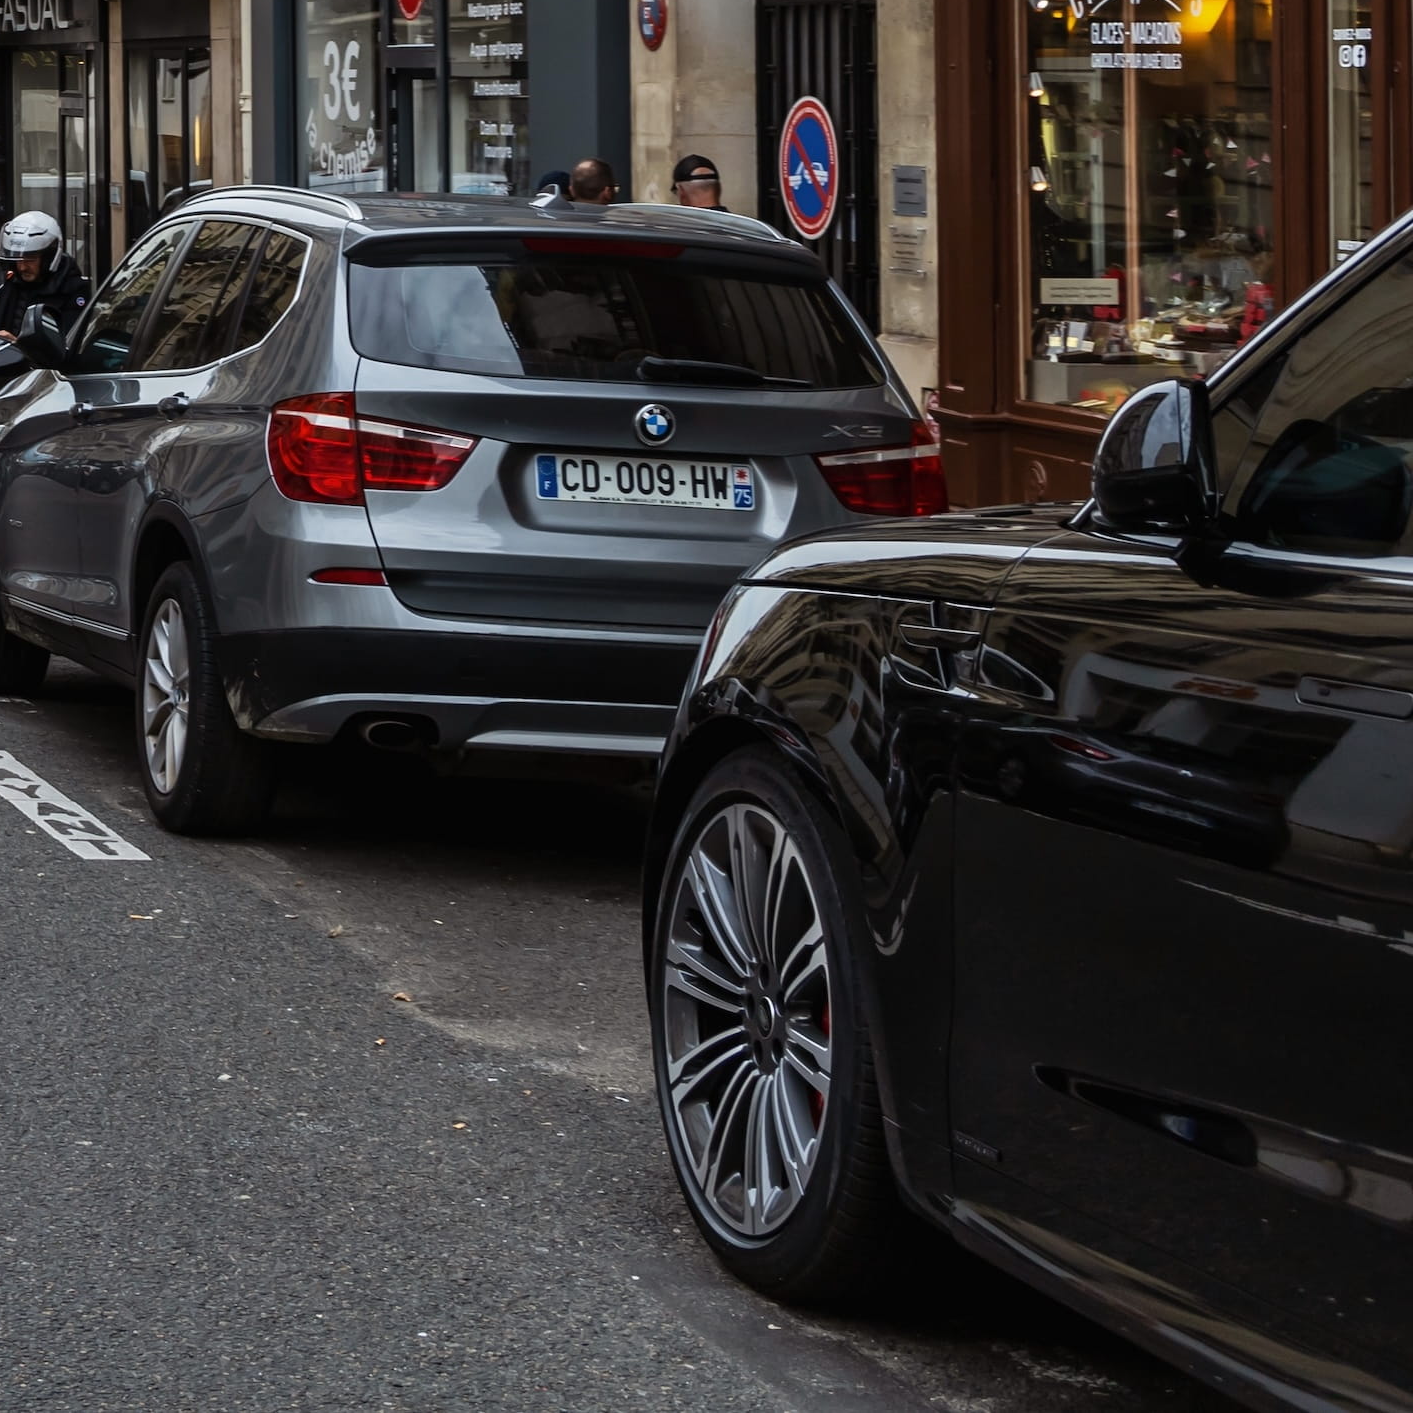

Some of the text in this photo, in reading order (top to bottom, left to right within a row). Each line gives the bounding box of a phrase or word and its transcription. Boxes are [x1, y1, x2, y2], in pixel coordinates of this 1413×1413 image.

[1091, 22, 1124, 44] GLACES
[1131, 22, 1181, 44] MACARONS
[324, 40, 361, 122] 3€
[305, 108, 318, 148] la
[823, 423, 883, 439] X3
[561, 458, 729, 500] CD-009-HW
[735, 488, 753, 505] 75
